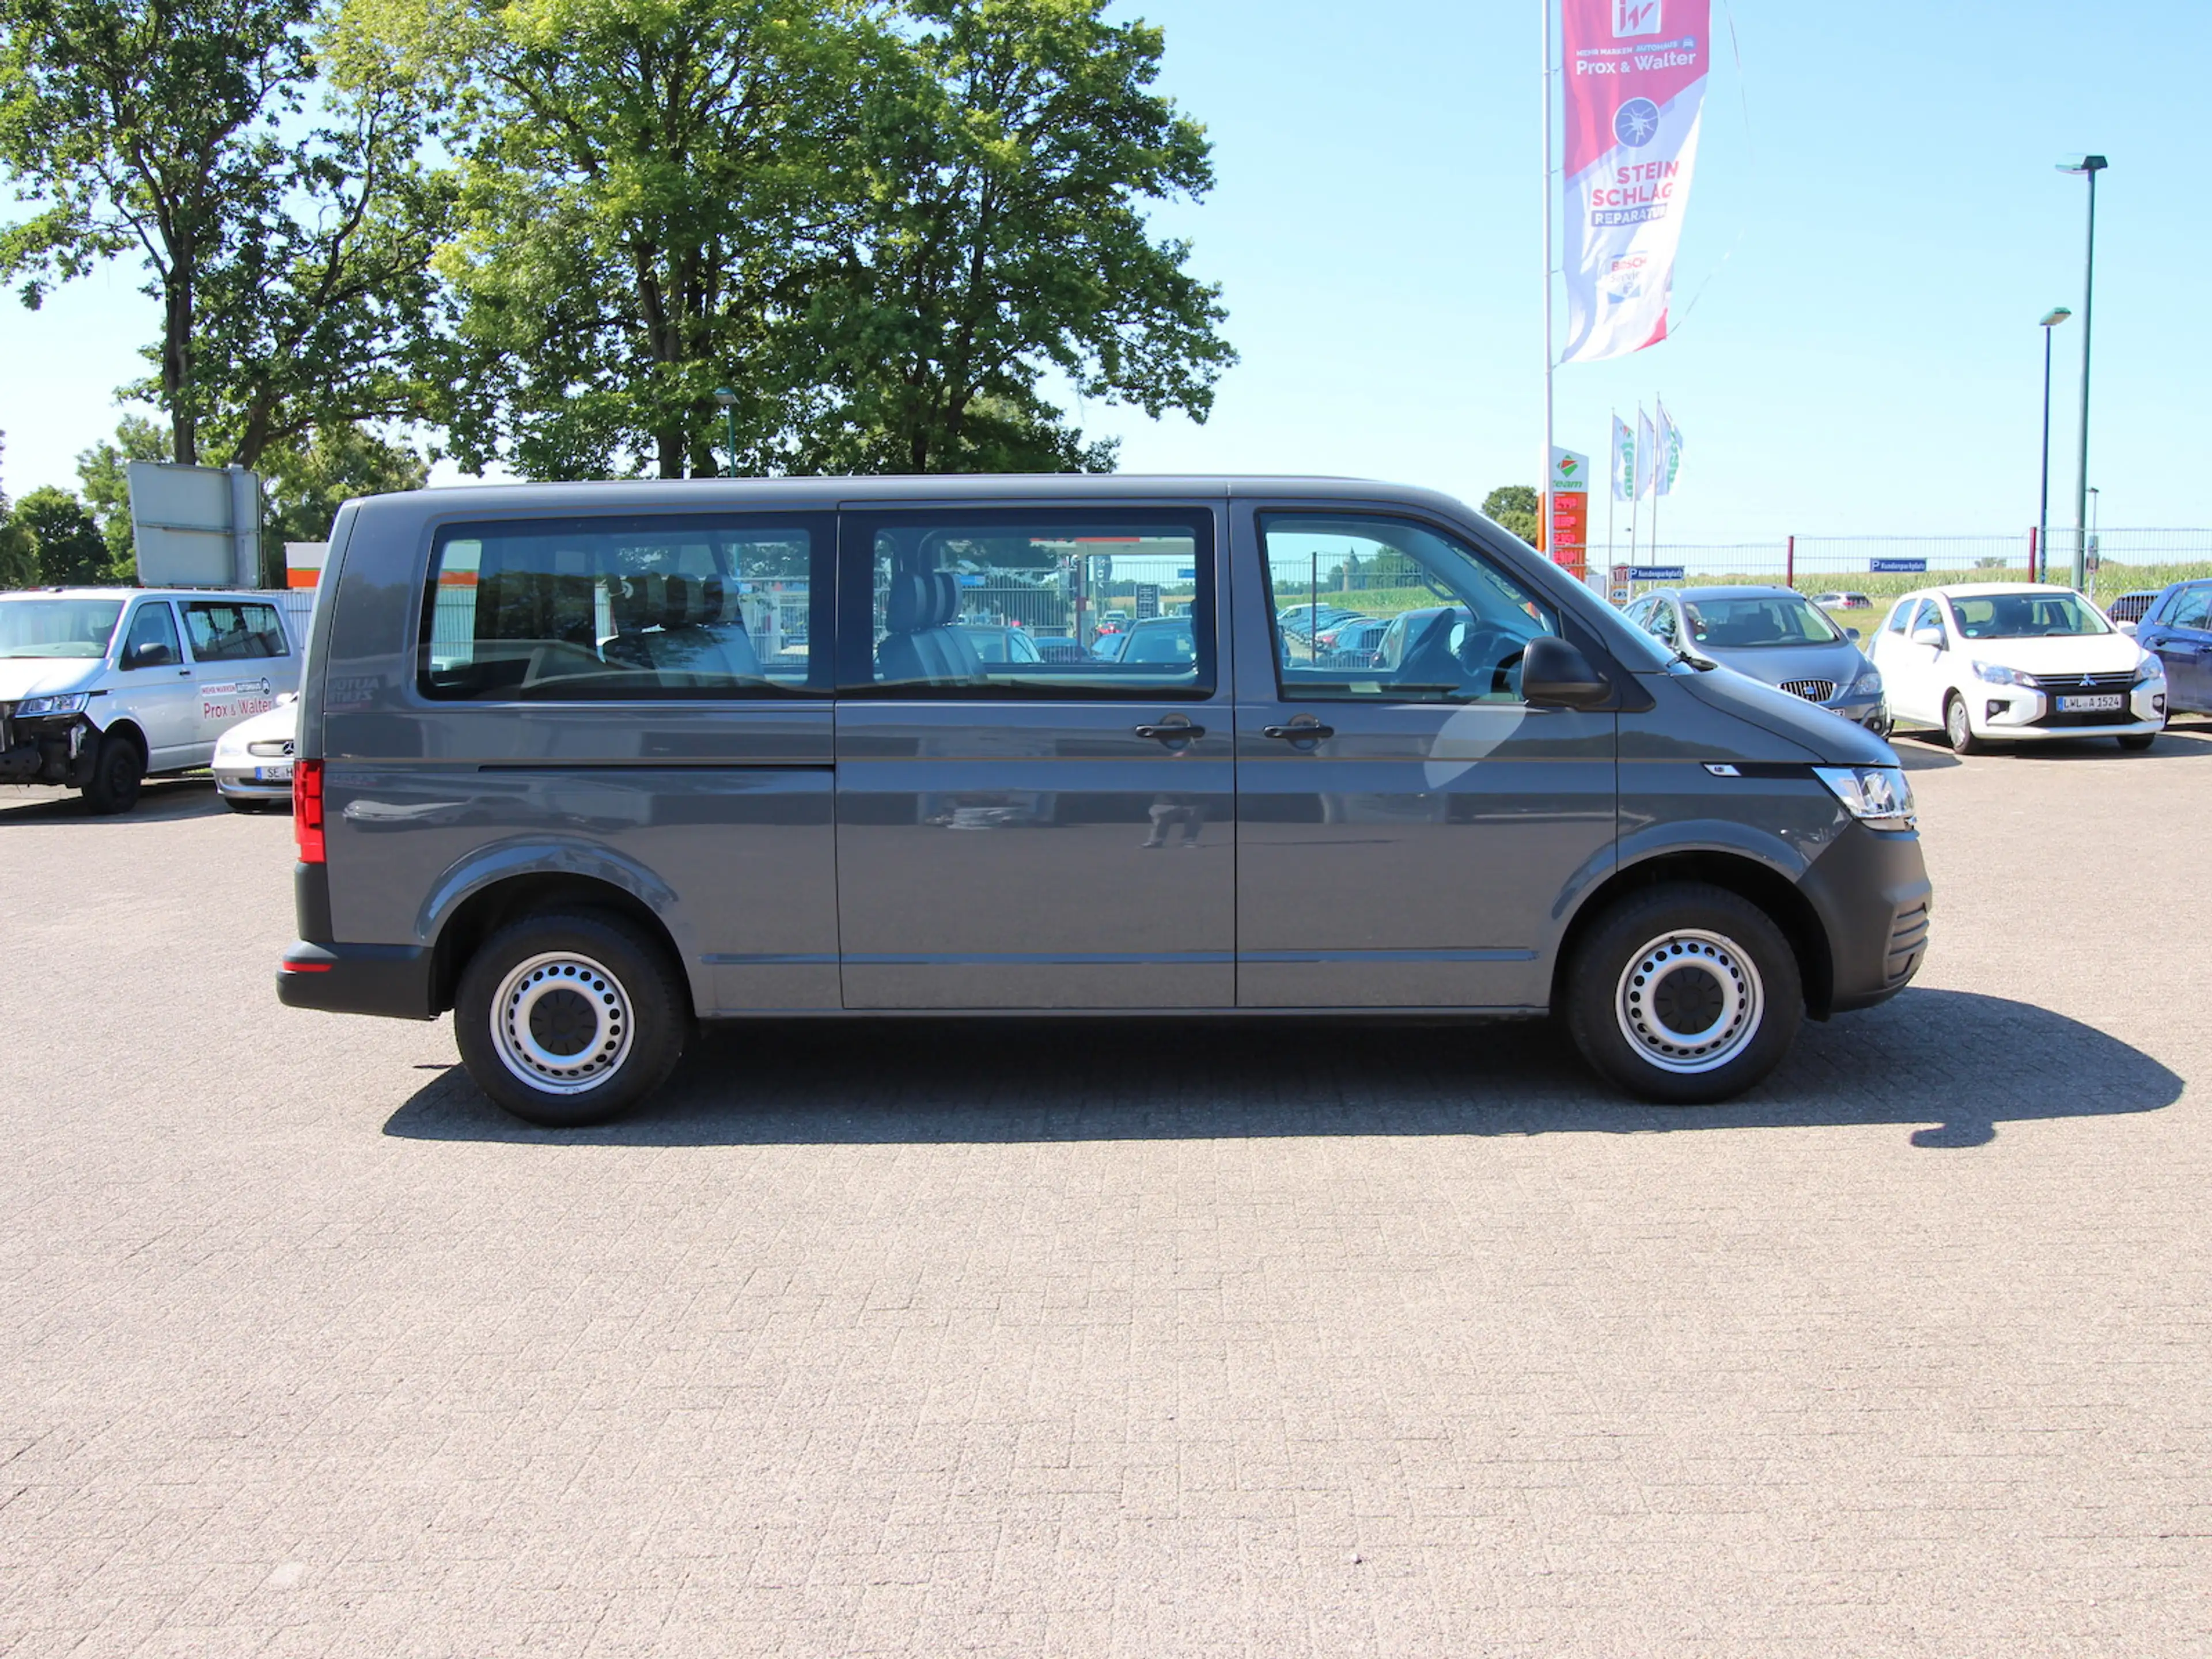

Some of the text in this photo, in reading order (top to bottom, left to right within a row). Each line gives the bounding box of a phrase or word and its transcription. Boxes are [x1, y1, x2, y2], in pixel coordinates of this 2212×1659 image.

[1600, 47, 1633, 55] MARKEN
[1635, 41, 1677, 52] AUTOHAUS
[1576, 51, 1696, 75] Prox & Walter
[1617, 161, 1679, 184] STEIN
[1592, 183, 1673, 207] SCHLAG
[1553, 479, 1583, 488] team
[204, 702, 228, 719] Prox
[237, 698, 272, 714] Walter
[2064, 698, 2081, 709] LWL
[2097, 696, 2119, 707] 1524
[267, 767, 280, 778] SE
